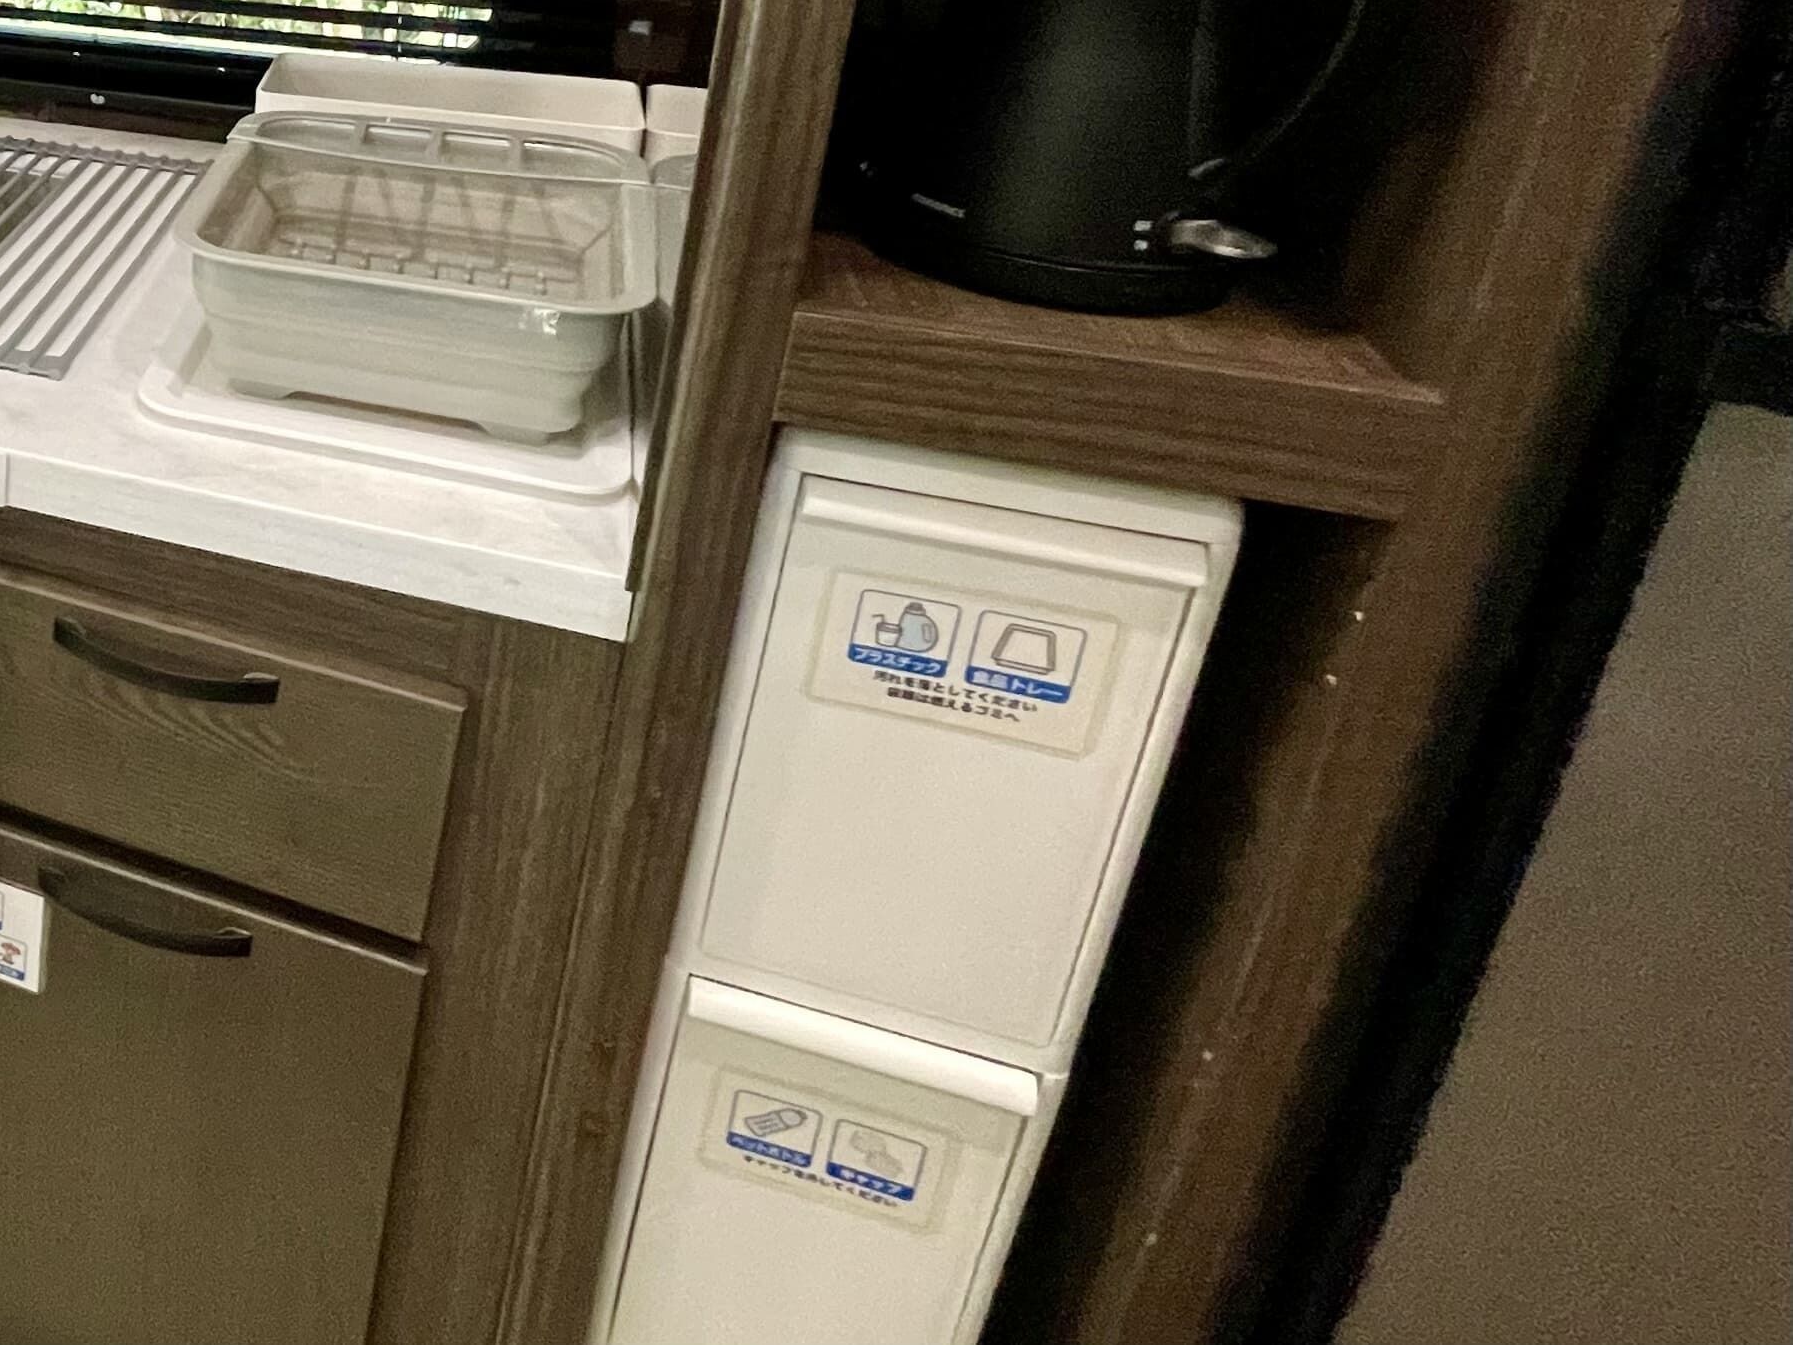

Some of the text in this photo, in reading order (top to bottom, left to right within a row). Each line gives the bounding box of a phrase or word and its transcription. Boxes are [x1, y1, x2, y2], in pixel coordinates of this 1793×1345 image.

[853, 646, 943, 675] プラスチック
[872, 669, 1038, 714] 汚れを落としてください
[971, 670, 1065, 697] 食品トレー
[839, 1168, 904, 1195] キャップ
